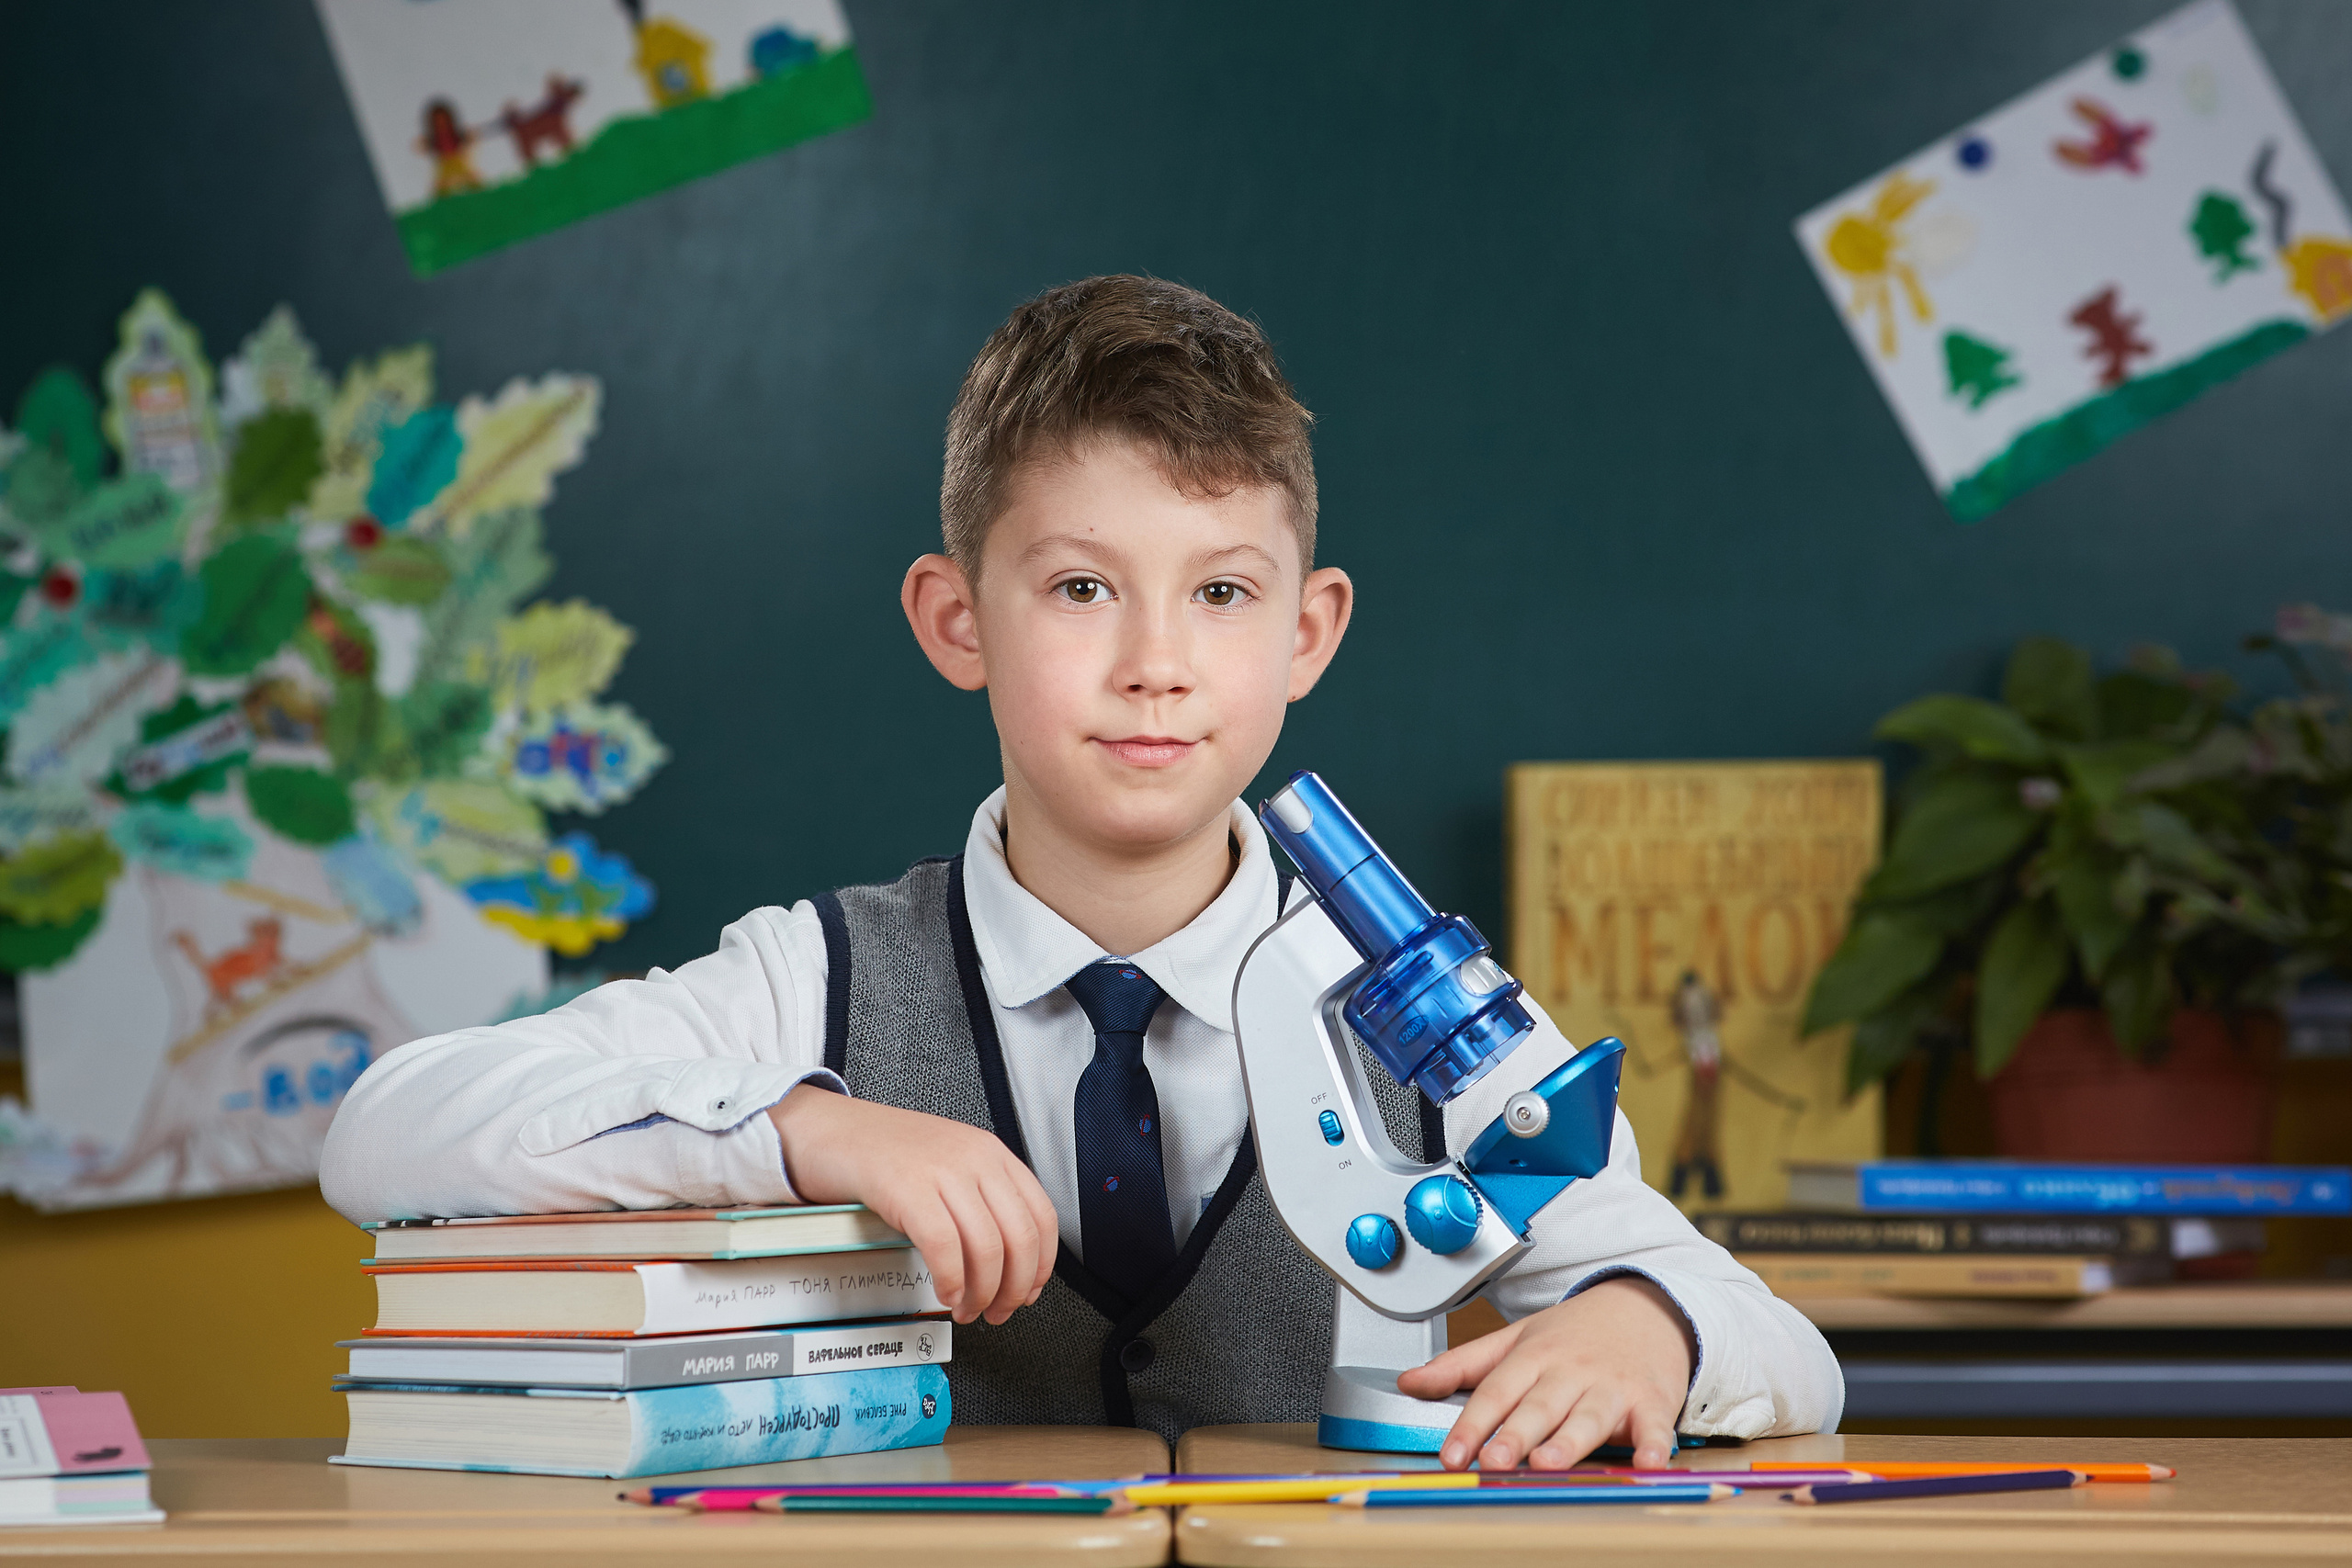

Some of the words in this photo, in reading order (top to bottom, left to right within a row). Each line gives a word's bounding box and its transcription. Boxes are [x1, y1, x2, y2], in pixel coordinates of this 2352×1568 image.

[1398, 1020, 1426, 1044] 1200X
[1311, 1092, 1327, 1104] OFF
[1339, 1159, 1351, 1169] ON
[743, 1285, 775, 1300] ПАРР
[789, 1278, 831, 1295] ТОНЯ
[839, 1271, 933, 1292] ГЛИММЕРДАЛ
[682, 1355, 735, 1376] МАРИЯ
[745, 1351, 780, 1371] ПАРР
[808, 1345, 863, 1364] ВАФЕЛЬНОЕ
[866, 1341, 904, 1359] СЕРДЦЕ
[854, 1406, 888, 1421] БЕЛСВИК
[890, 1402, 907, 1417] РУНЕ
